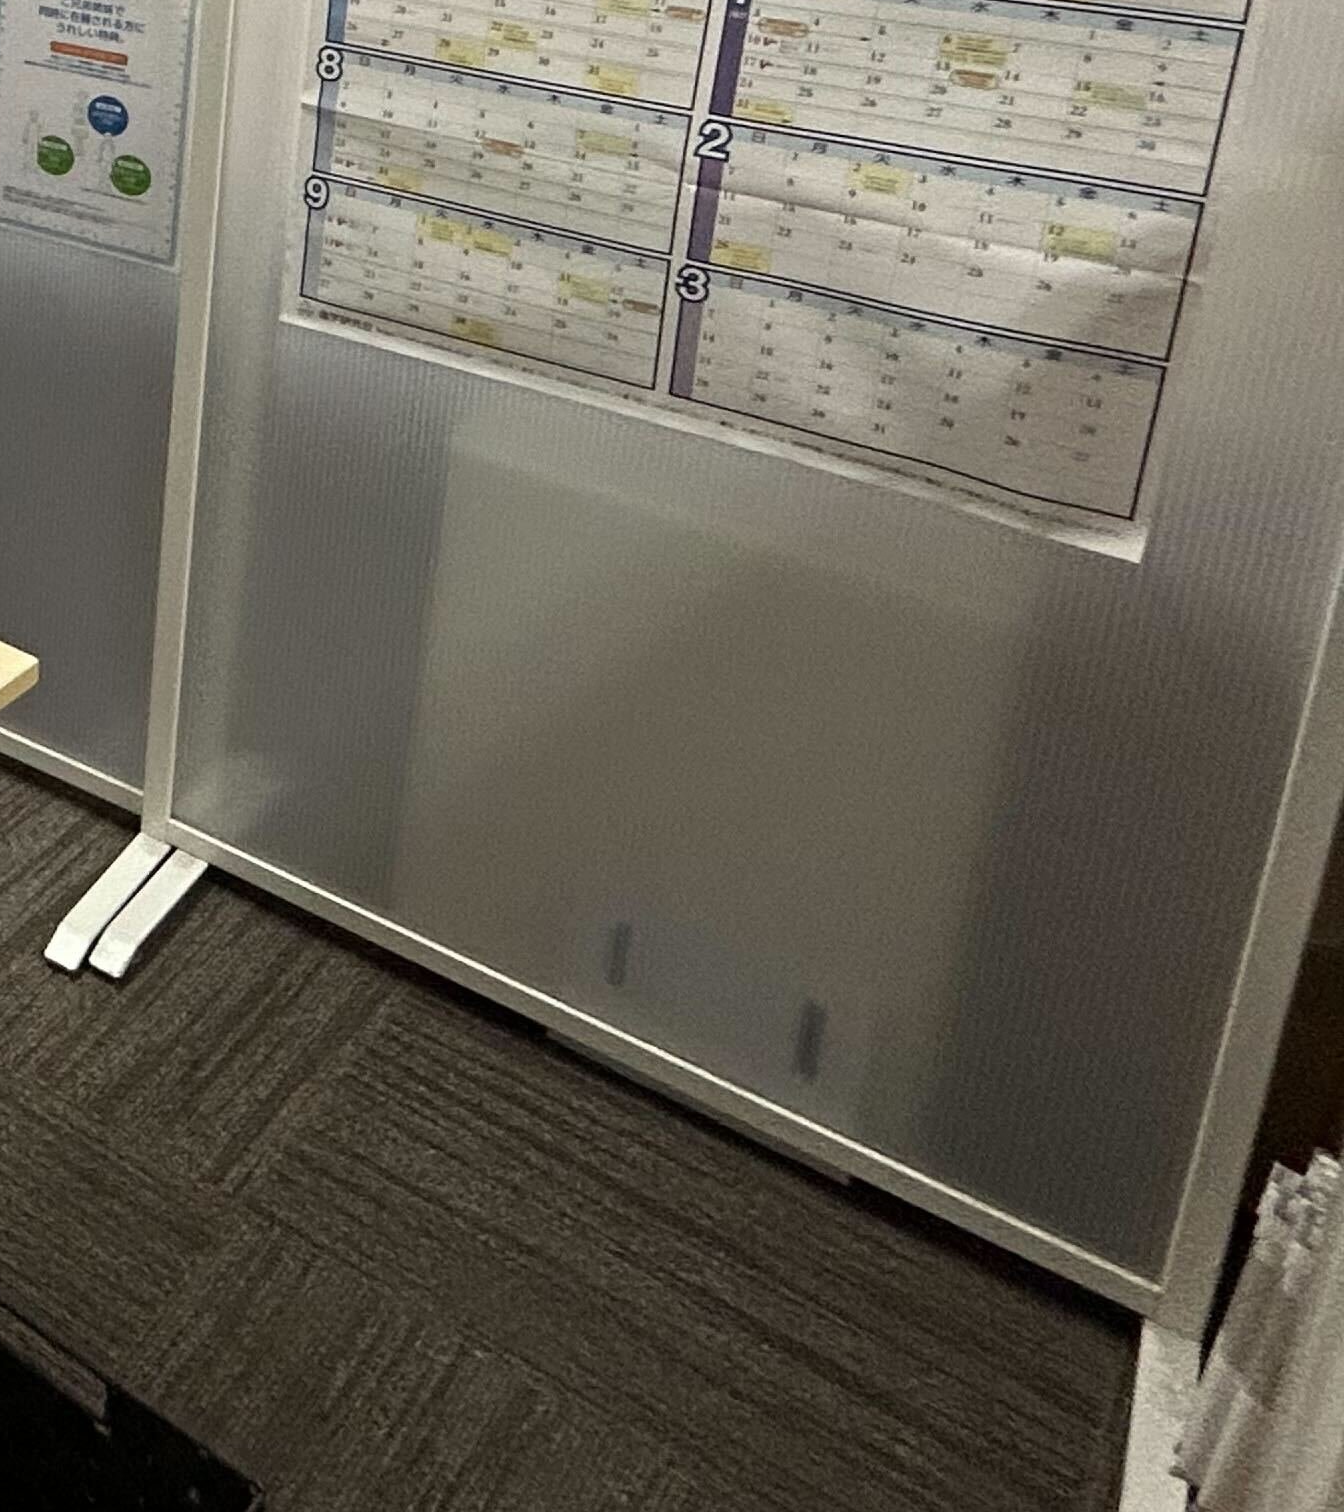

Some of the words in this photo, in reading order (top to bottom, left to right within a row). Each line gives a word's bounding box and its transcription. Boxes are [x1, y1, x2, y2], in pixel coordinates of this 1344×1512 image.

[316, 47, 343, 80] 8
[695, 122, 732, 161] 2
[305, 175, 329, 209] 9
[676, 266, 710, 303] 3
